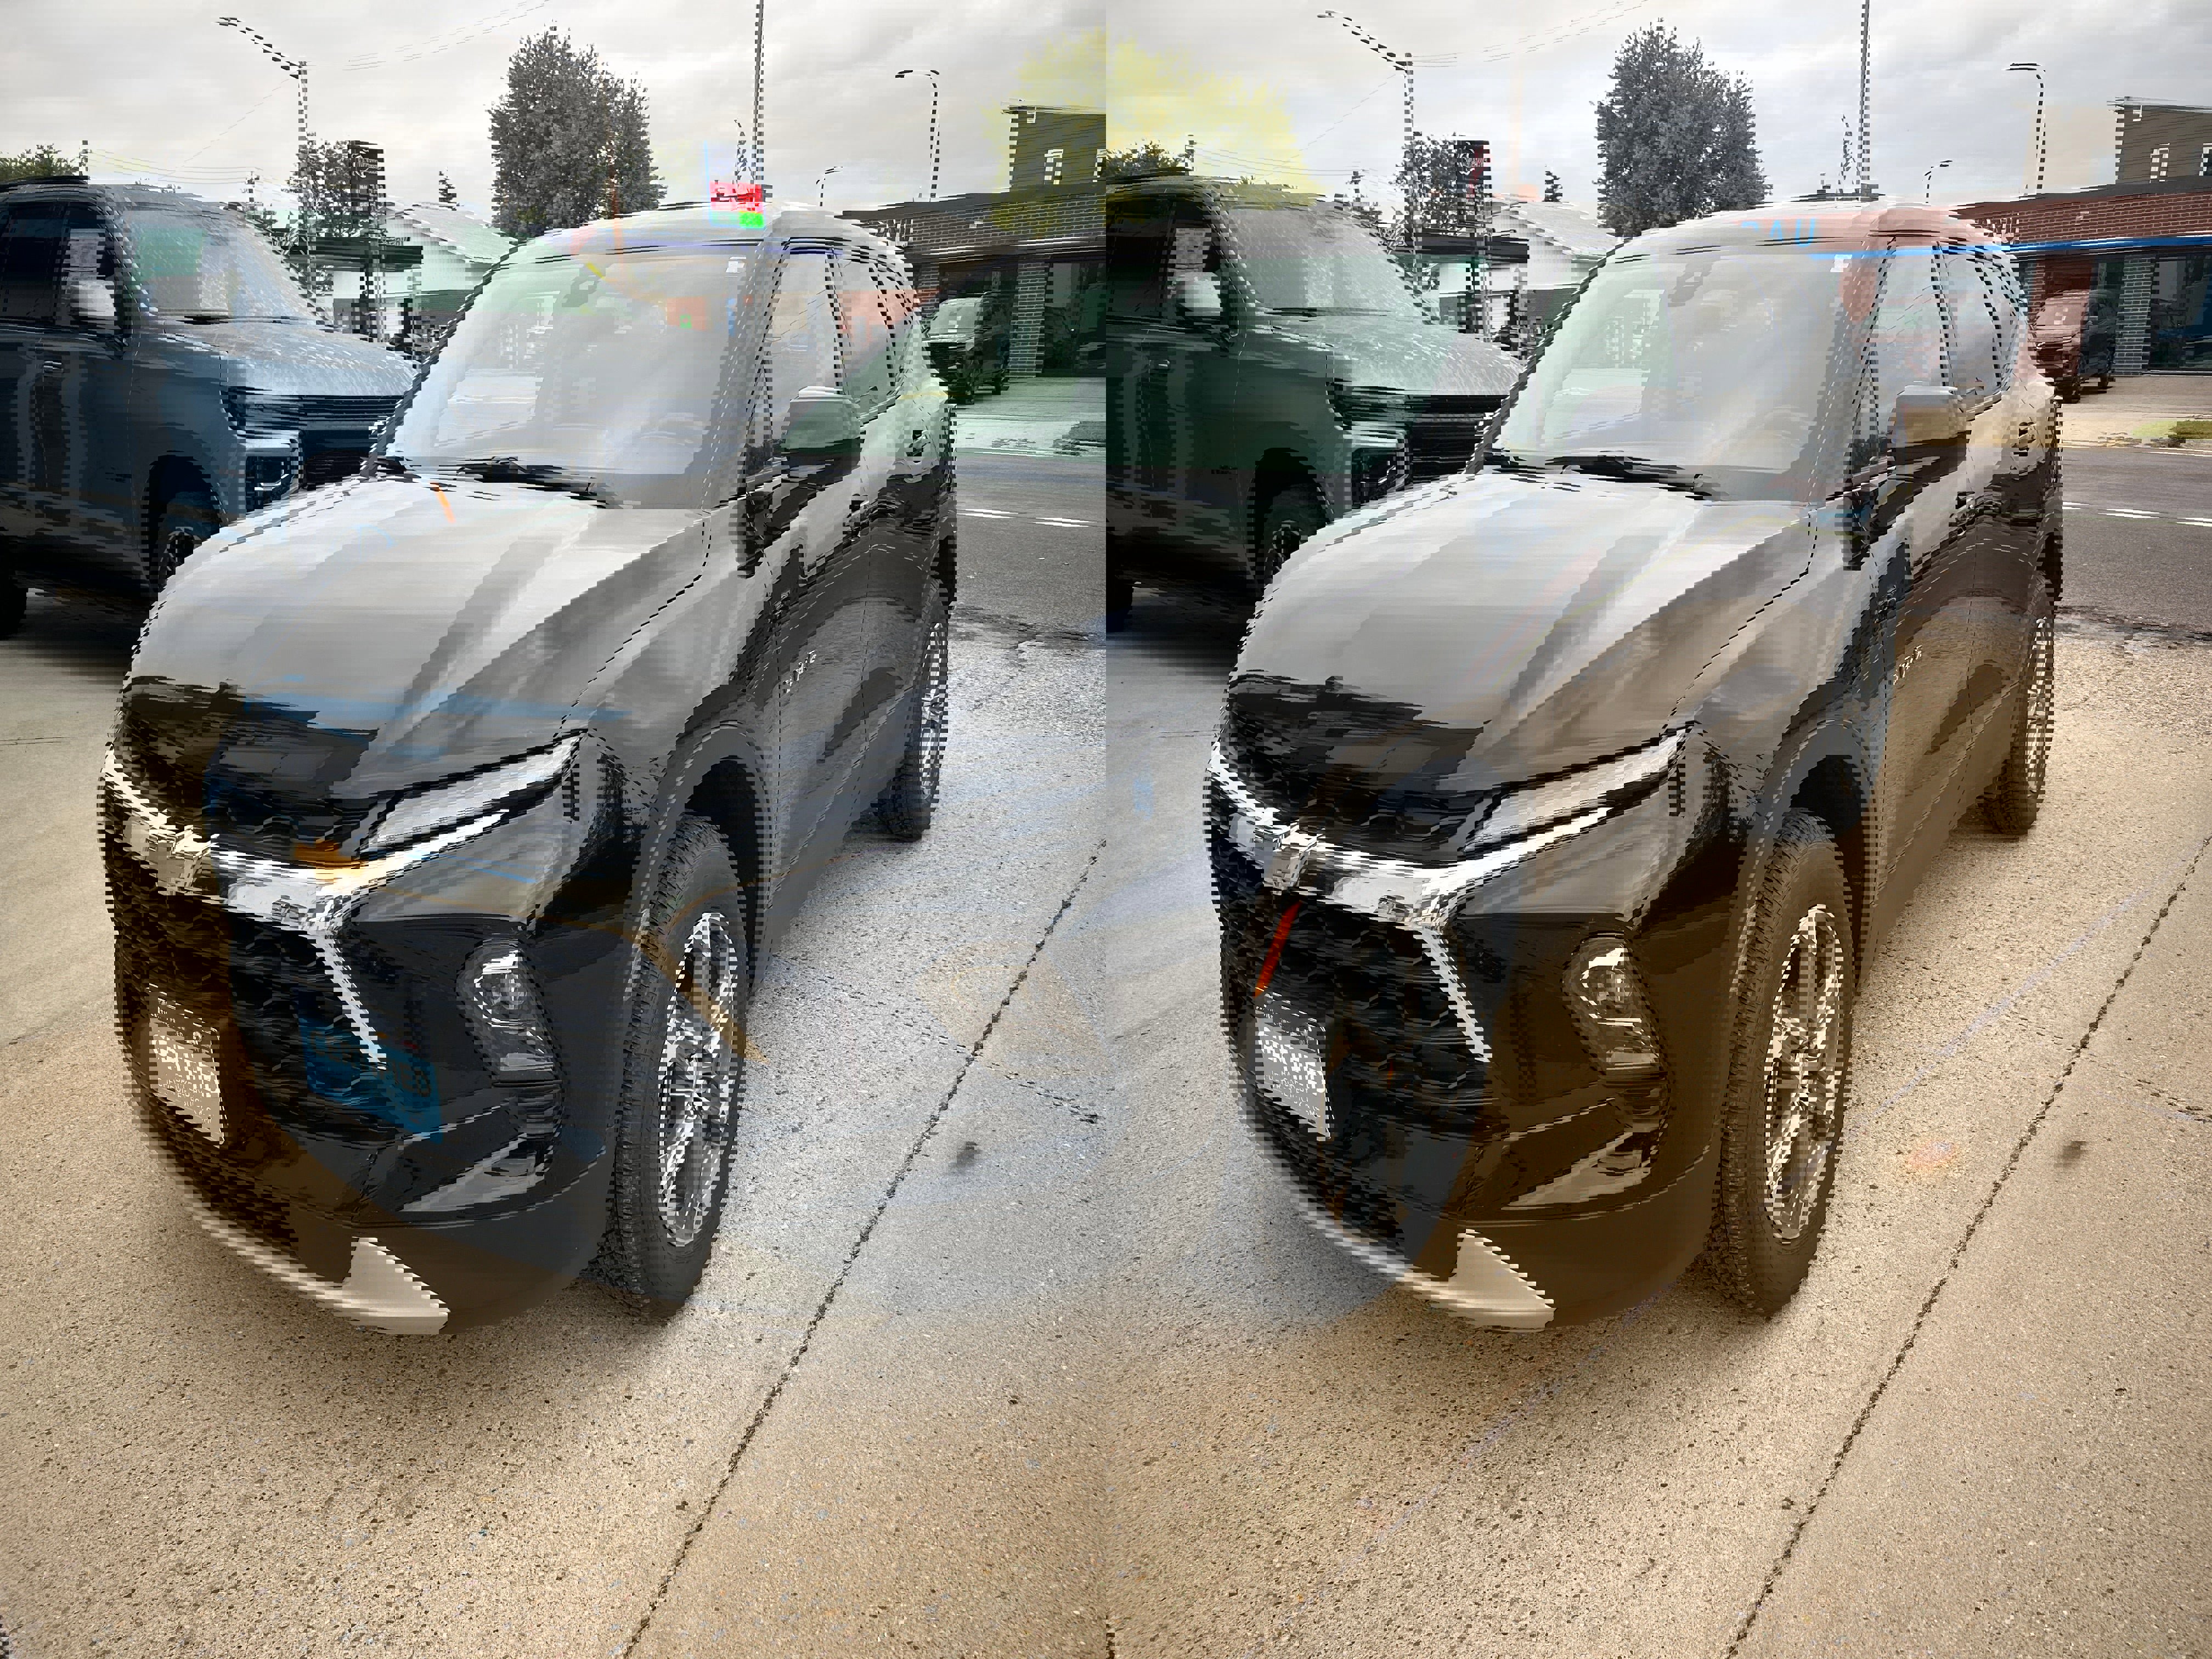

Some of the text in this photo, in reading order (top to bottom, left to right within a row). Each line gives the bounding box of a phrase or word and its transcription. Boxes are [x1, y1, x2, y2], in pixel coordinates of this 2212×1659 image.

[718, 215, 731, 223] DSL
[1573, 645, 1634, 690] BLAZER
[308, 1006, 368, 1034] CERTIFIED PRE-OWNED
[309, 1029, 431, 1098] CERTIFIED
[324, 1074, 425, 1122] CHEVROLET BUICK & GMC
[351, 1074, 396, 1098] BACKED BY
